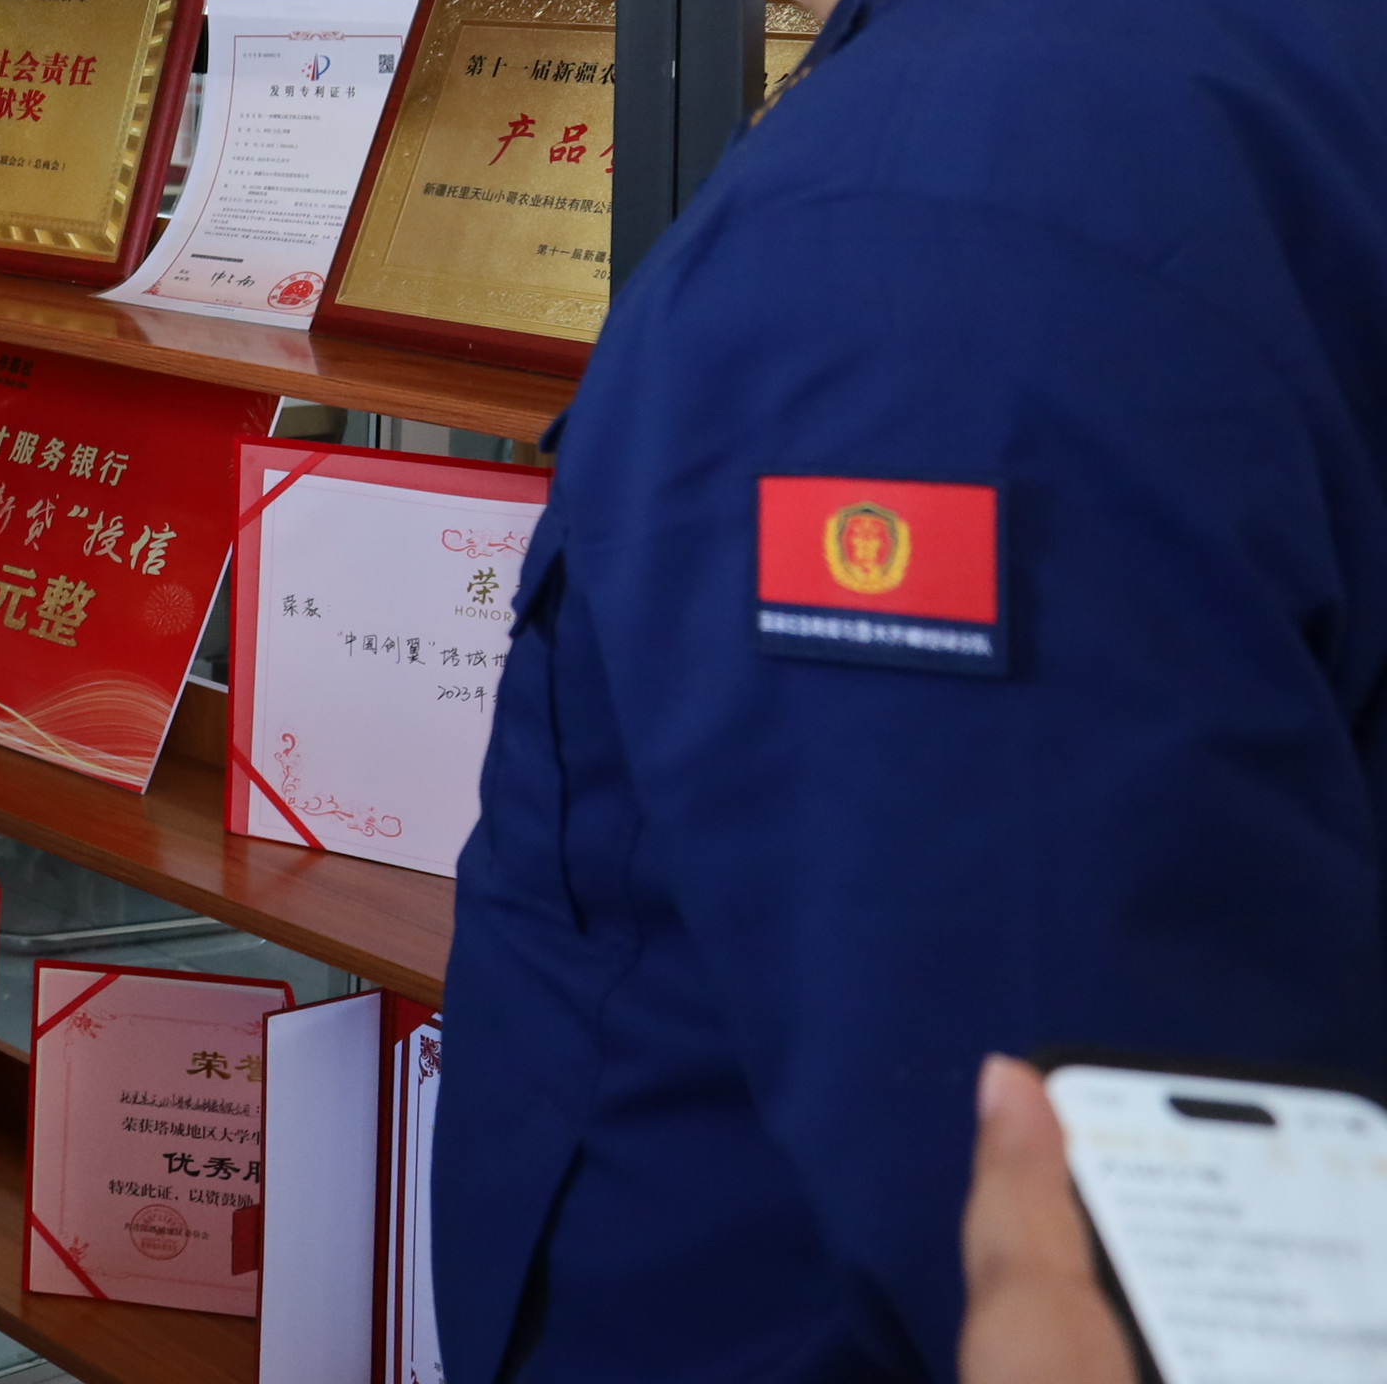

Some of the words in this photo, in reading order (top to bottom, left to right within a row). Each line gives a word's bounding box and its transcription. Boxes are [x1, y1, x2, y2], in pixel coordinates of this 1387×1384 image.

[270, 85, 356, 99] 发明专利证书
[437, 684, 499, 713] 2023年
